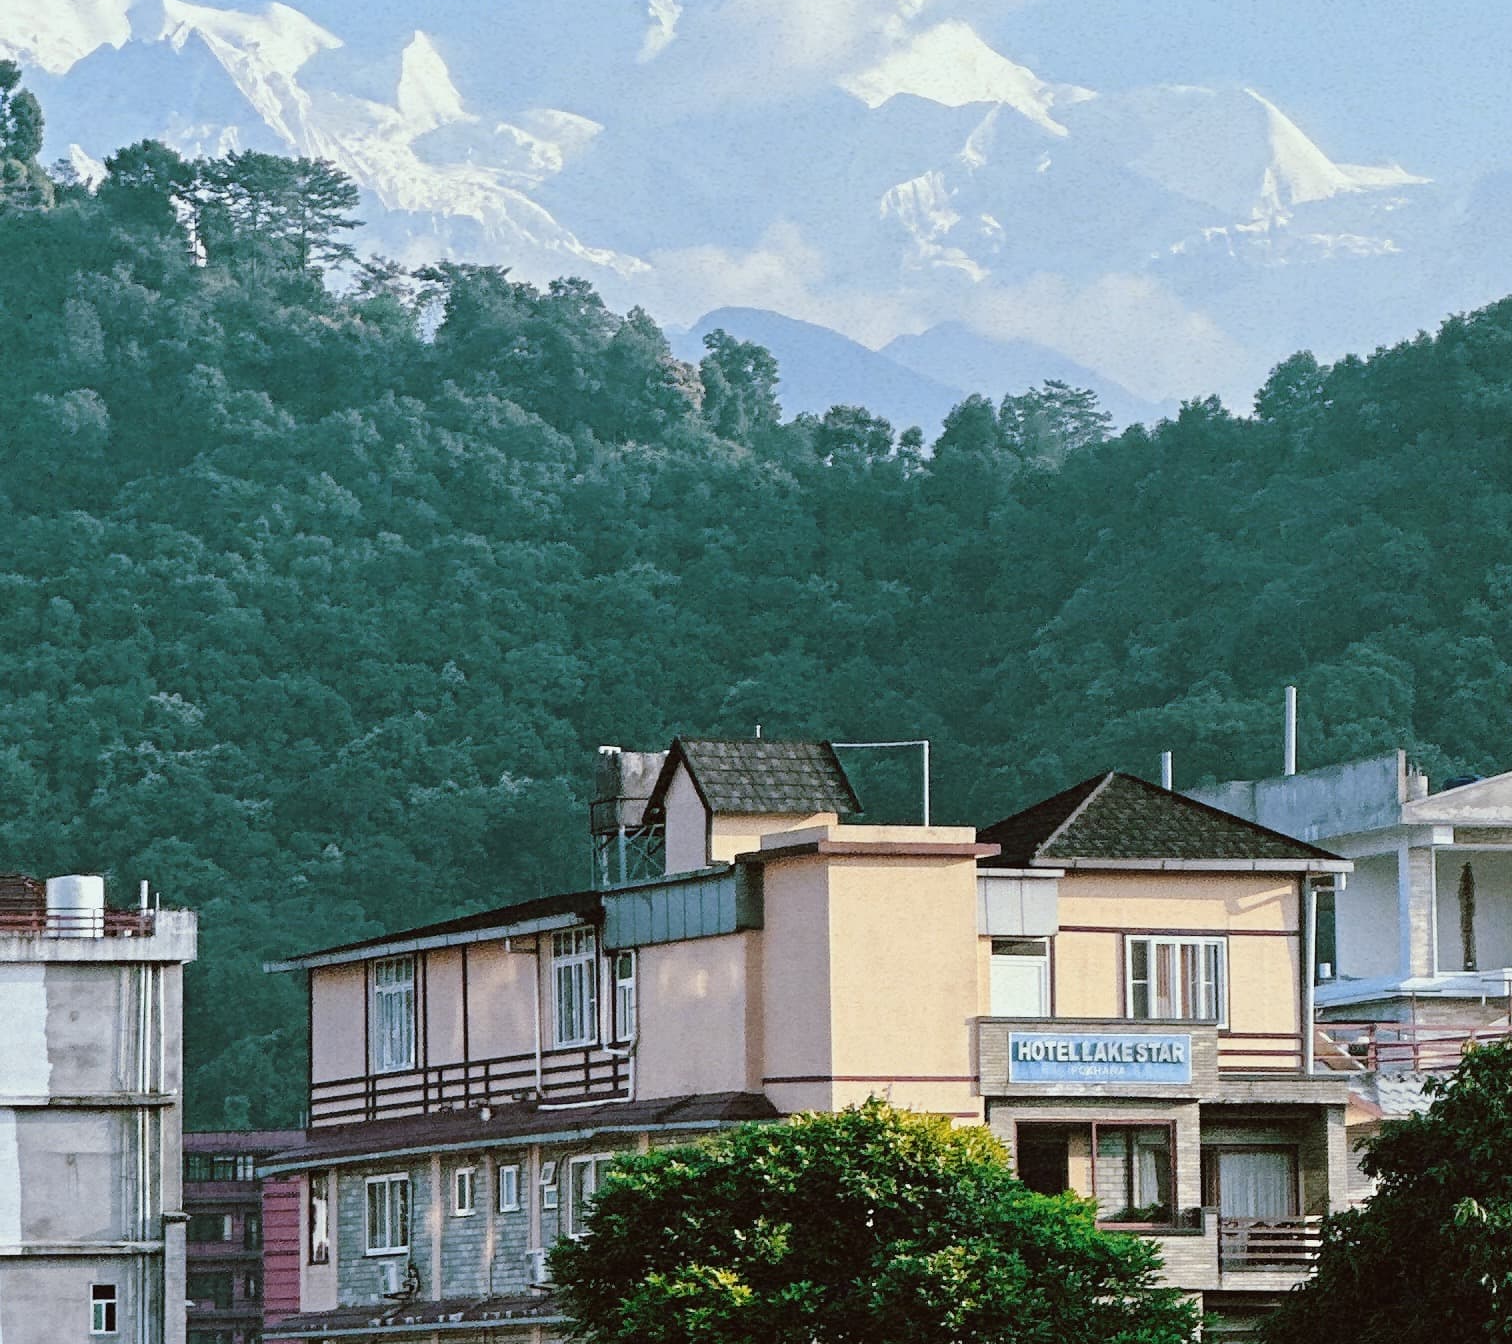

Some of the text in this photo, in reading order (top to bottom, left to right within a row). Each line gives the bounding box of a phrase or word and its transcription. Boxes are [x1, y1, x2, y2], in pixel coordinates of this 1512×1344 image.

[1018, 1041, 1185, 1063] HOTEL LAKE STAR
